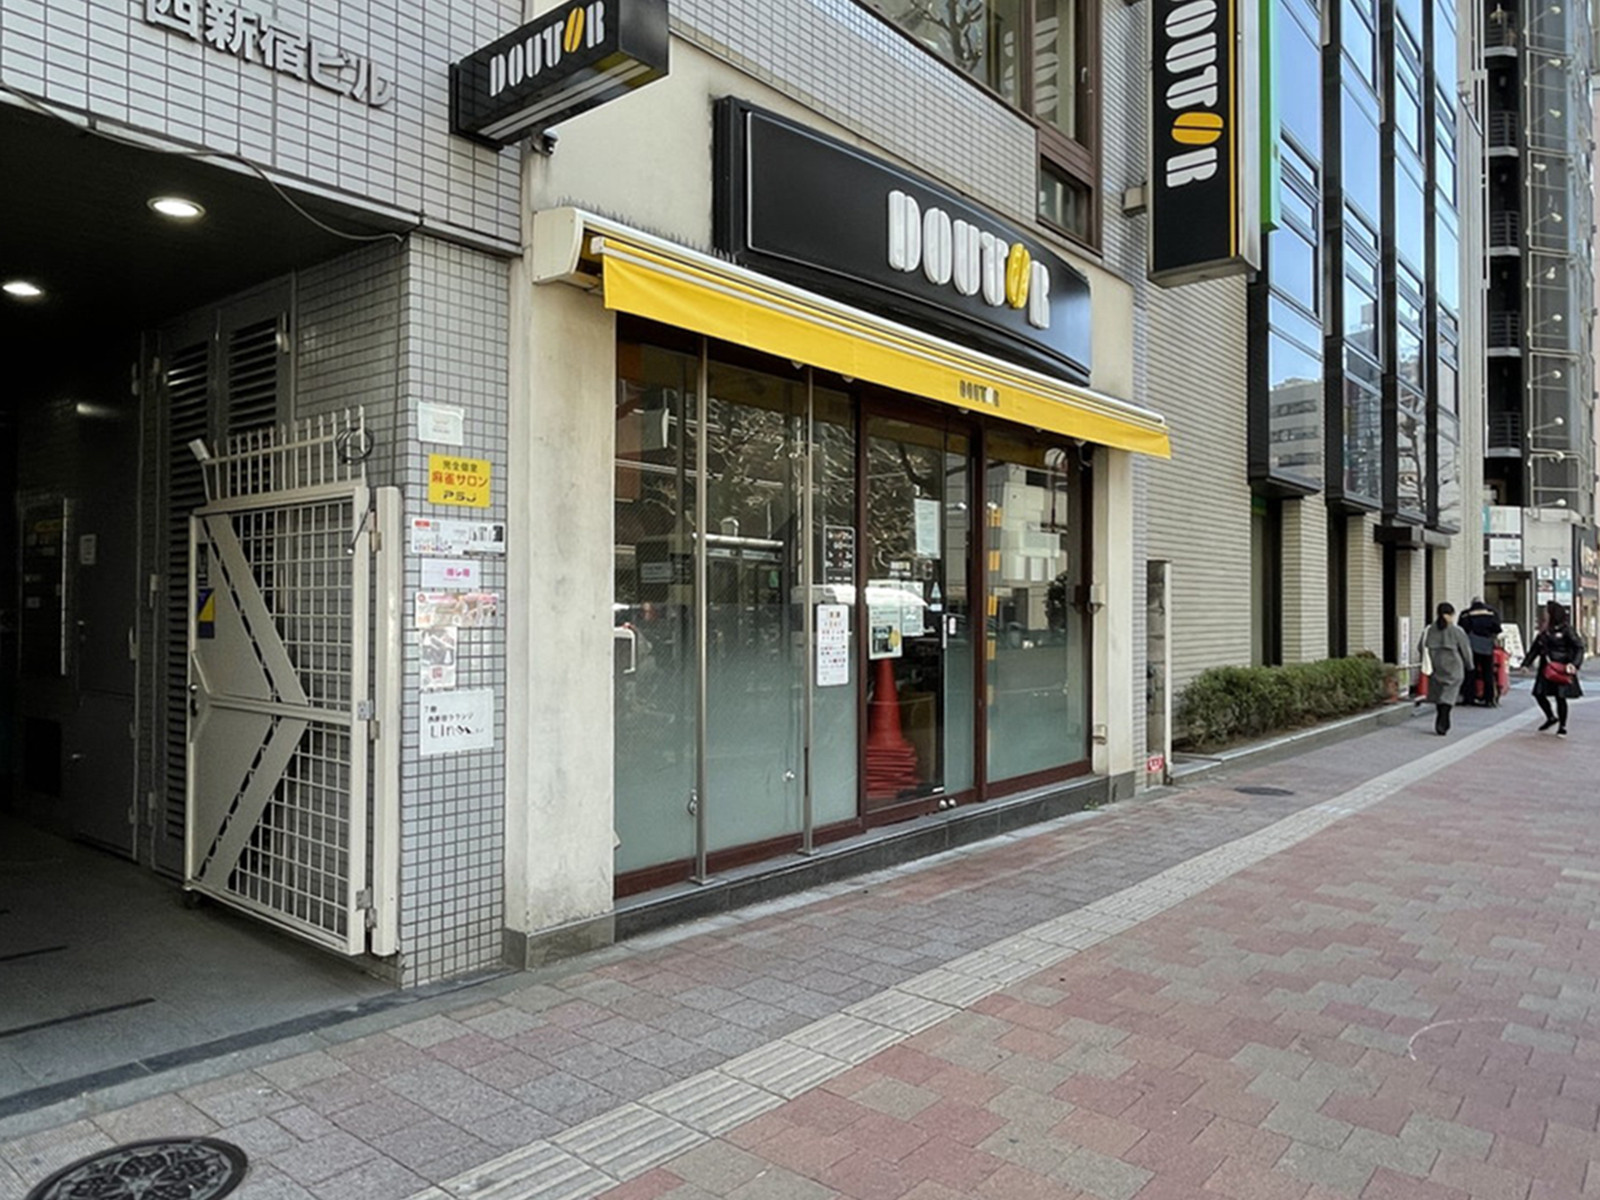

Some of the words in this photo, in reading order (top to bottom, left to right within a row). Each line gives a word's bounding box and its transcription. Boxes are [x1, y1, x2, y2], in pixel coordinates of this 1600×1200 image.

[145, 0, 396, 107] 西新宿ビル
[489, 1, 605, 97] DOUTOR
[1165, 0, 1224, 188] OUTOR
[888, 190, 1050, 329] DOUTOR
